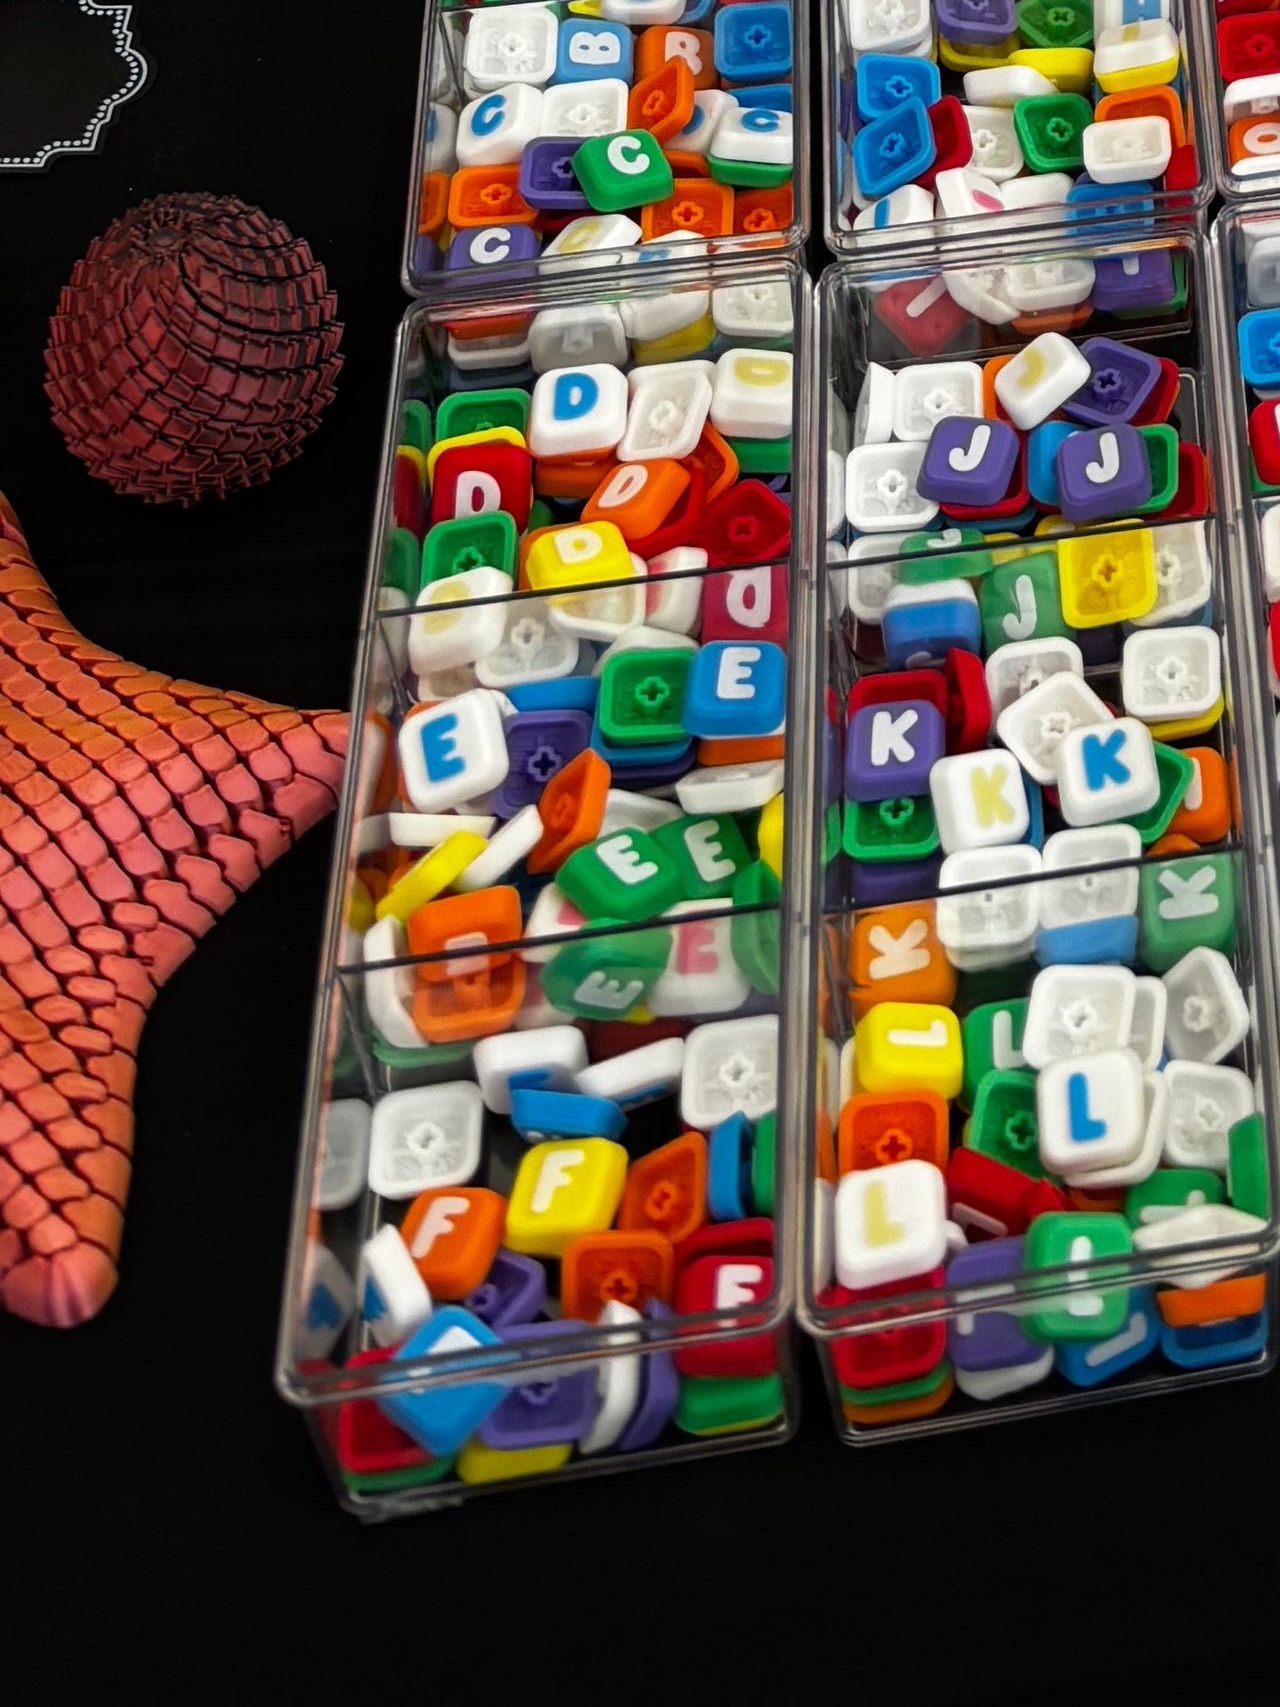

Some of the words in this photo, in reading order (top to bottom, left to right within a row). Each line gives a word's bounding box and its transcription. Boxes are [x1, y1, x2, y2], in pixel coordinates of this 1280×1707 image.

[570, 32, 620, 64] B
[471, 95, 504, 136] C
[742, 108, 778, 131] C
[607, 136, 649, 174] C
[470, 228, 510, 263] C
[554, 374, 597, 420] D
[949, 425, 990, 471] J
[1086, 433, 1119, 483] J
[455, 471, 500, 519] D
[598, 465, 647, 507] D
[555, 529, 601, 563] D
[1003, 575, 1037, 639] J
[717, 647, 760, 699] E
[421, 715, 464, 782] E
[871, 710, 918, 765] K
[1082, 728, 1131, 783] K
[972, 768, 1013, 826] K
[596, 835, 657, 884] E
[684, 821, 735, 882] E
[675, 922, 719, 974] E
[1069, 1074, 1105, 1142] L
[531, 1150, 584, 1212] F
[412, 1196, 470, 1258] F
[865, 1183, 903, 1247] L
